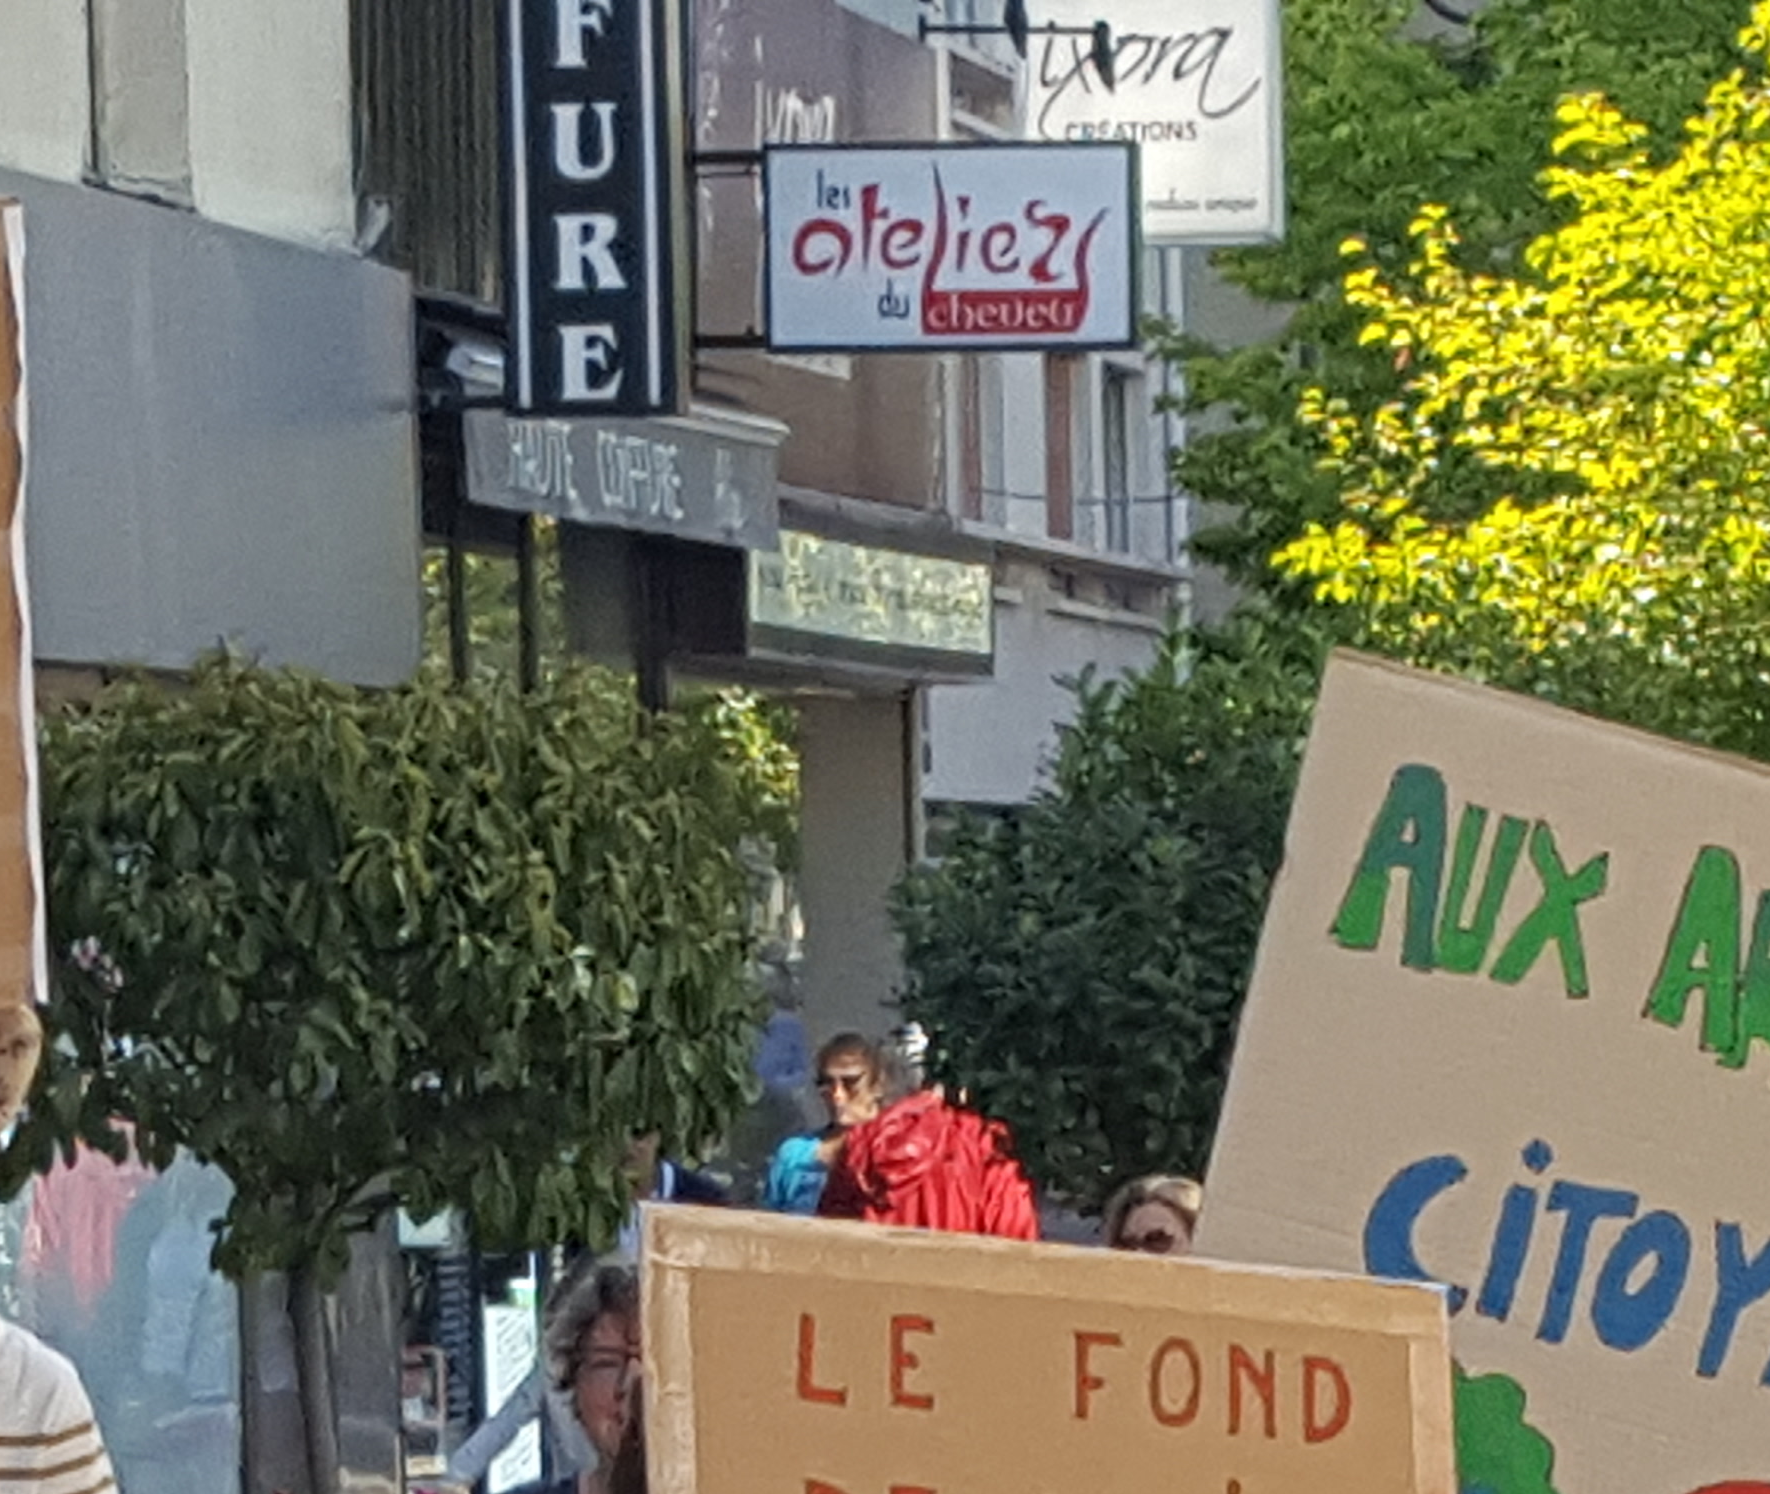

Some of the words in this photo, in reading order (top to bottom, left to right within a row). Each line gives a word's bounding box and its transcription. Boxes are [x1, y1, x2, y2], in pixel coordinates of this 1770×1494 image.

[816, 168, 851, 210] les
[878, 278, 911, 320] du
[1328, 763, 1610, 1000] AUX
[795, 1311, 937, 1412] LE
[1072, 1330, 1353, 1444] FOND
